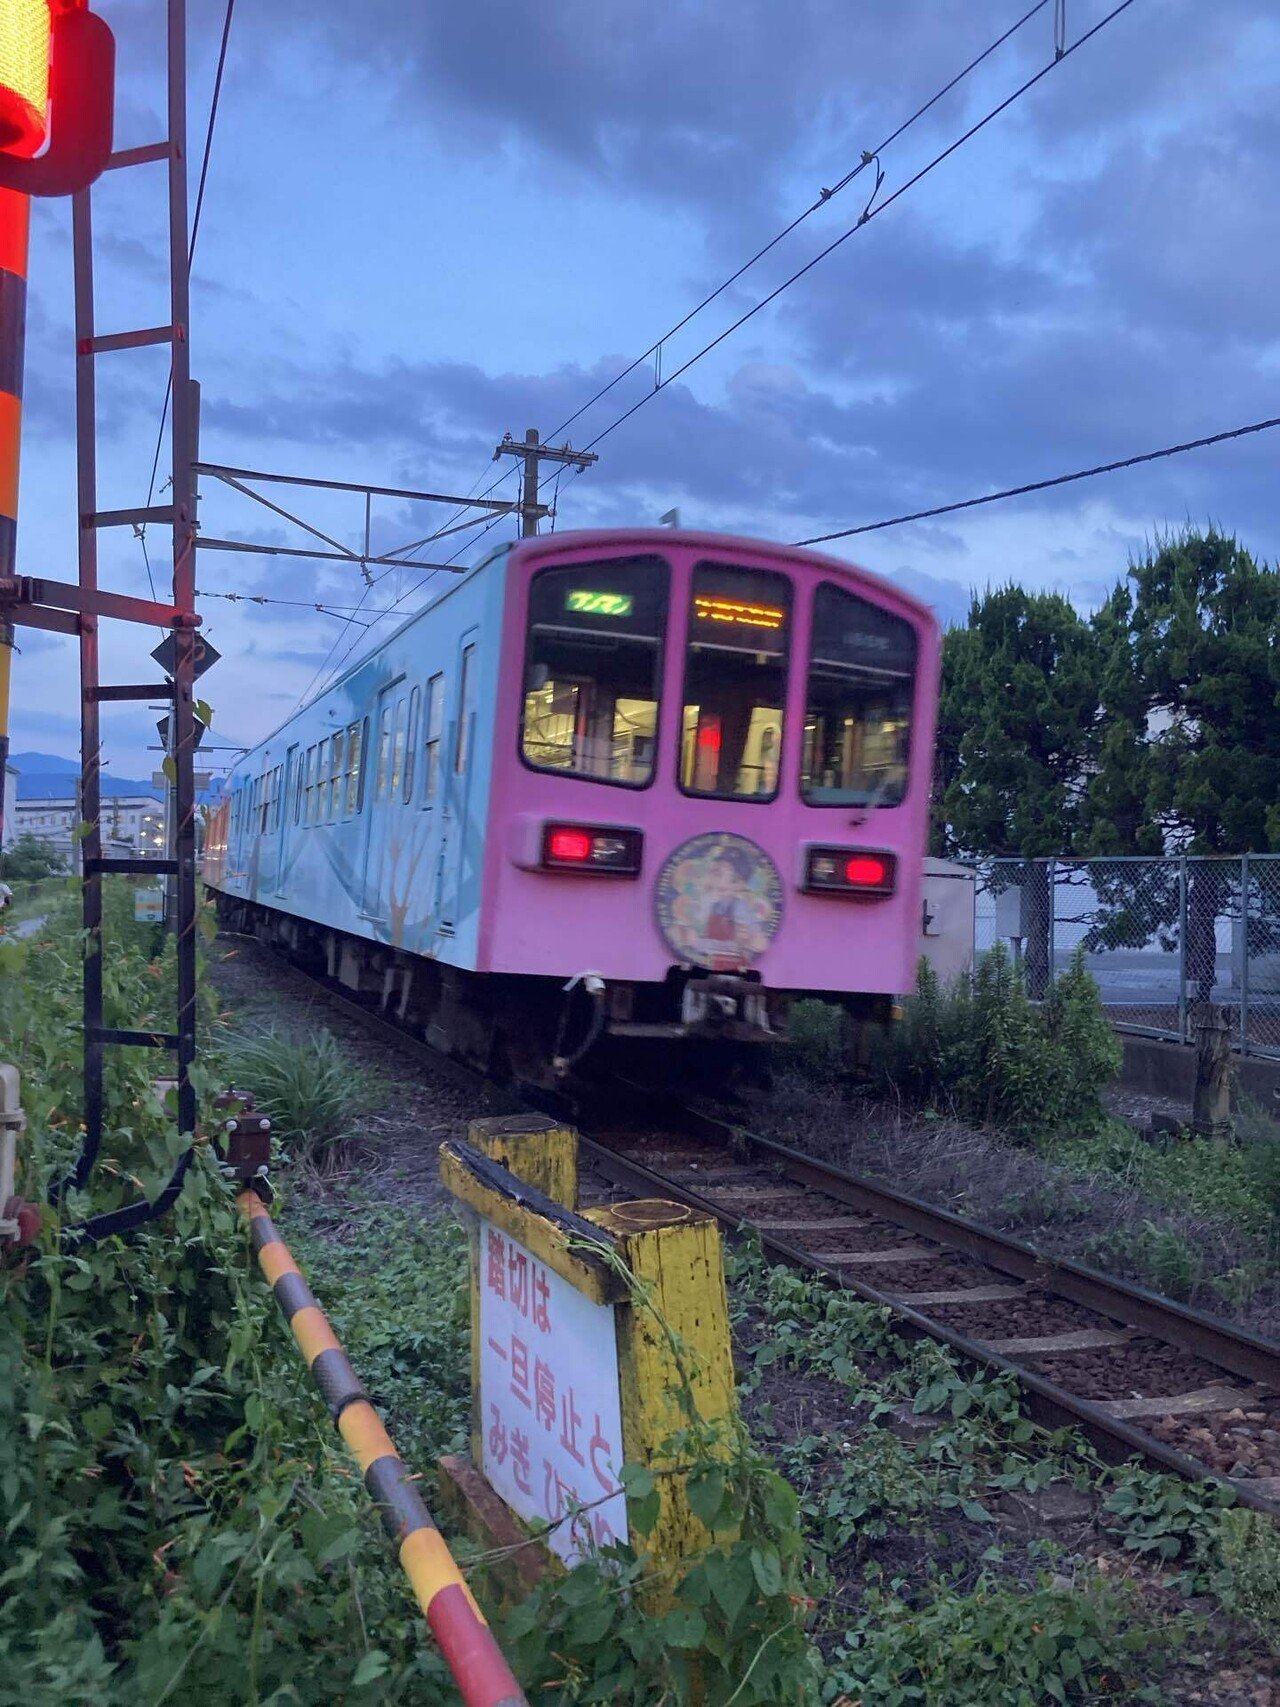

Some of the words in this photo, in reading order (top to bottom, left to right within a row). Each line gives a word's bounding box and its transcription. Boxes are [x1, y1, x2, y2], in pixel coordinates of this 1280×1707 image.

[488, 1334, 614, 1494] 一旦停止と
